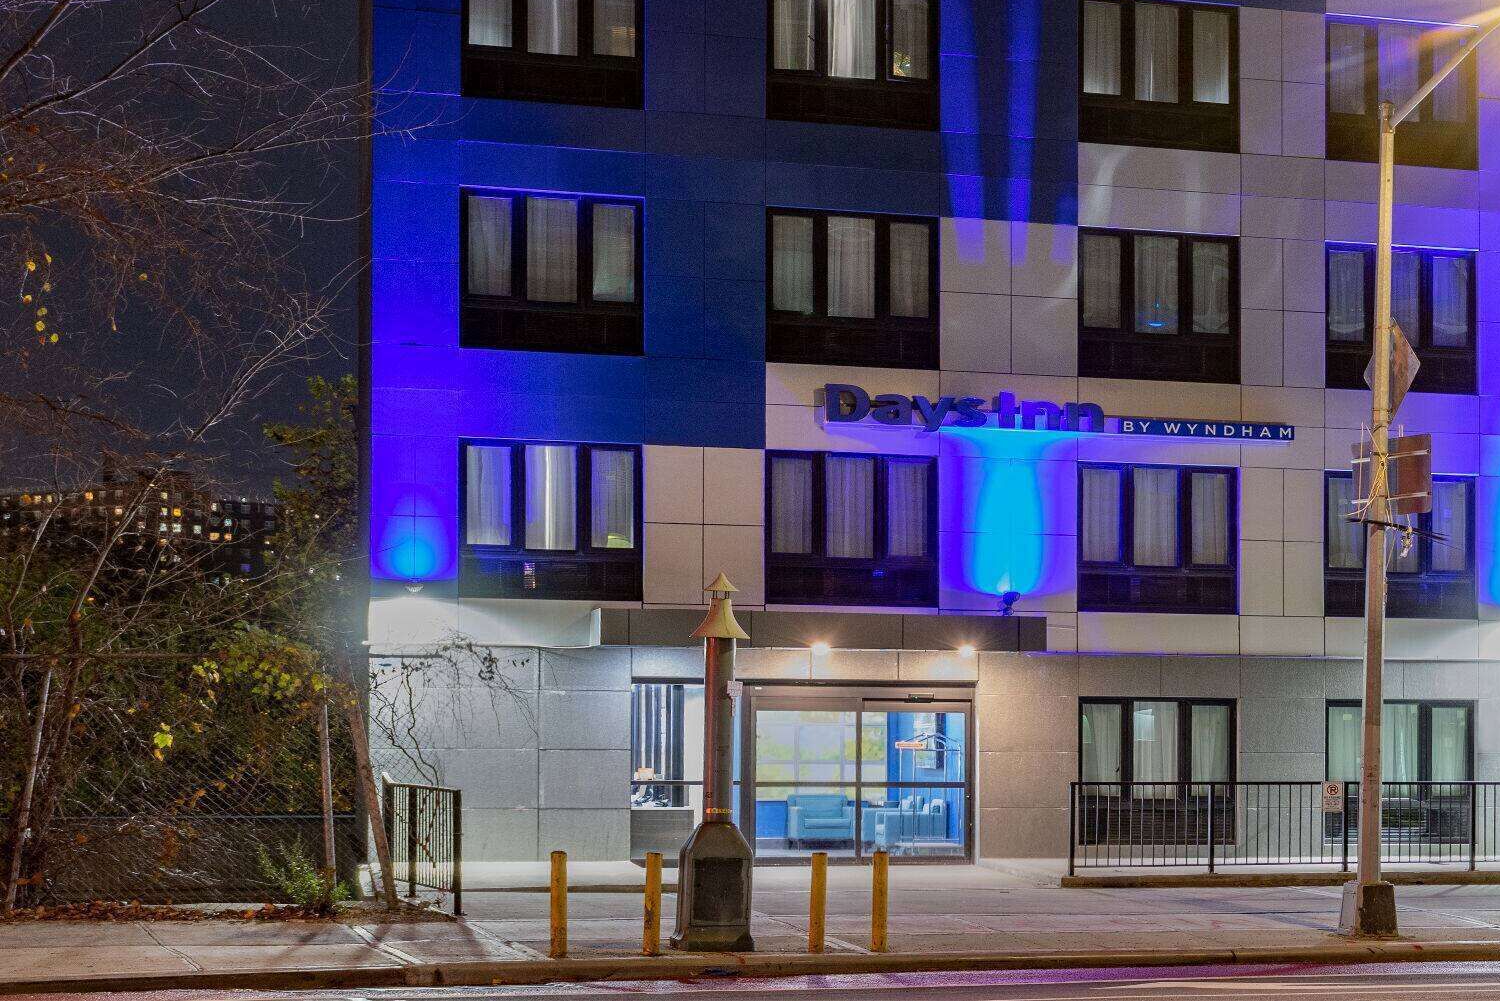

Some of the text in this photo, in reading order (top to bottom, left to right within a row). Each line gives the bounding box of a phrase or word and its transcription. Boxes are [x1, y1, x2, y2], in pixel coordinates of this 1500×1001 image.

[823, 383, 1293, 439] Days Inn BY WYNDHAM
